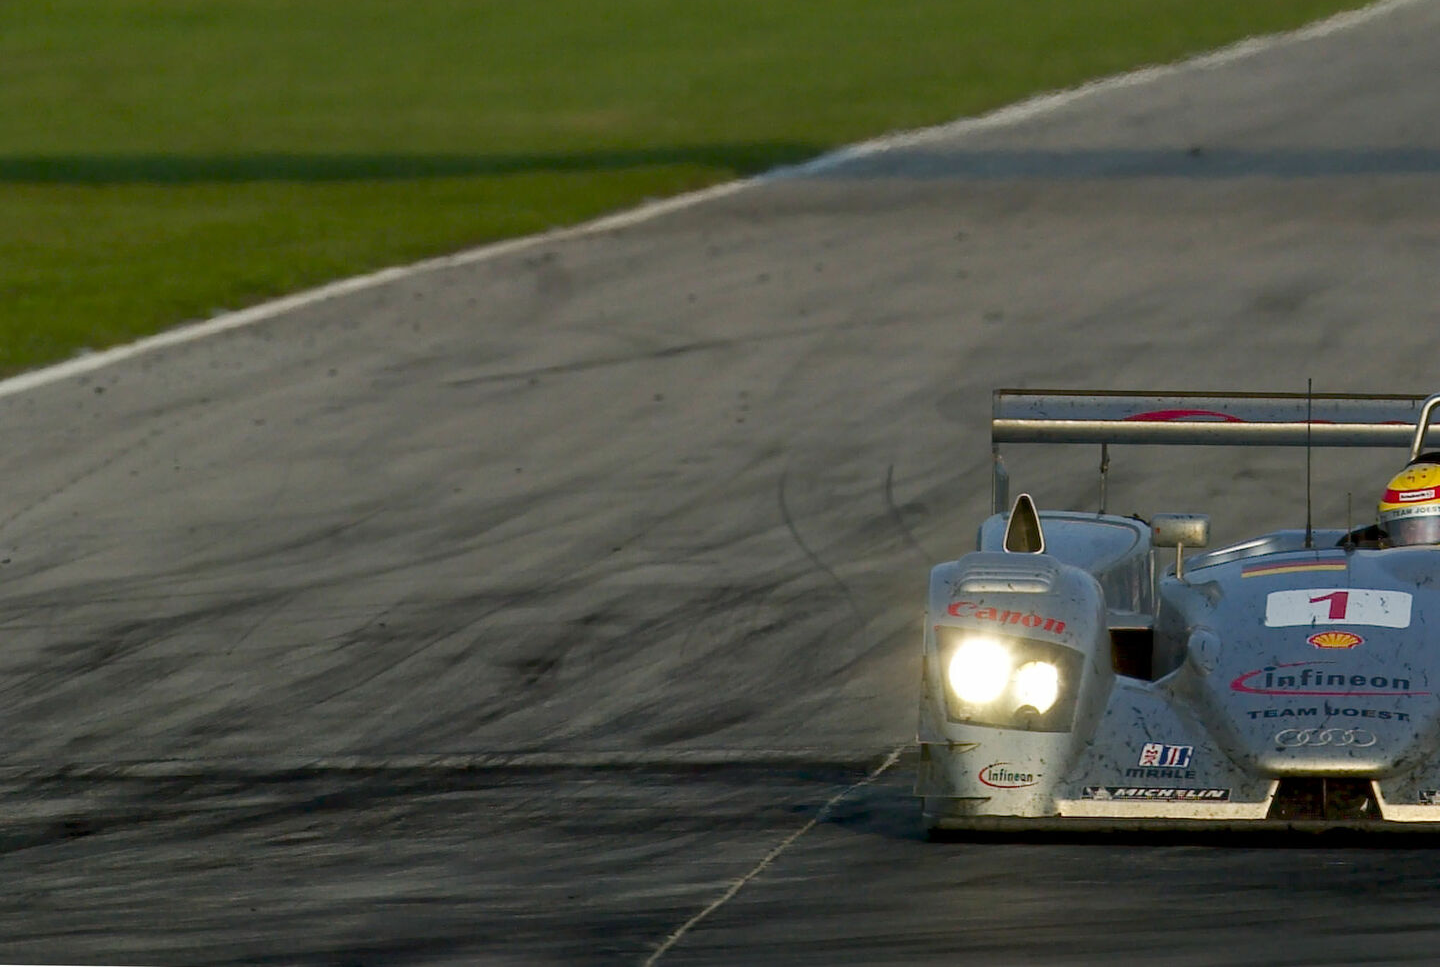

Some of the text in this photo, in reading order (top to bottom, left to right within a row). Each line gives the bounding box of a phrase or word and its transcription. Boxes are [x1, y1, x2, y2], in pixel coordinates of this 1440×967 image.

[1309, 591, 1349, 620] 1
[946, 601, 1067, 635] Canon
[1247, 706, 1410, 722] TEAM JOEST
[1114, 788, 1226, 798] MICHELIN
